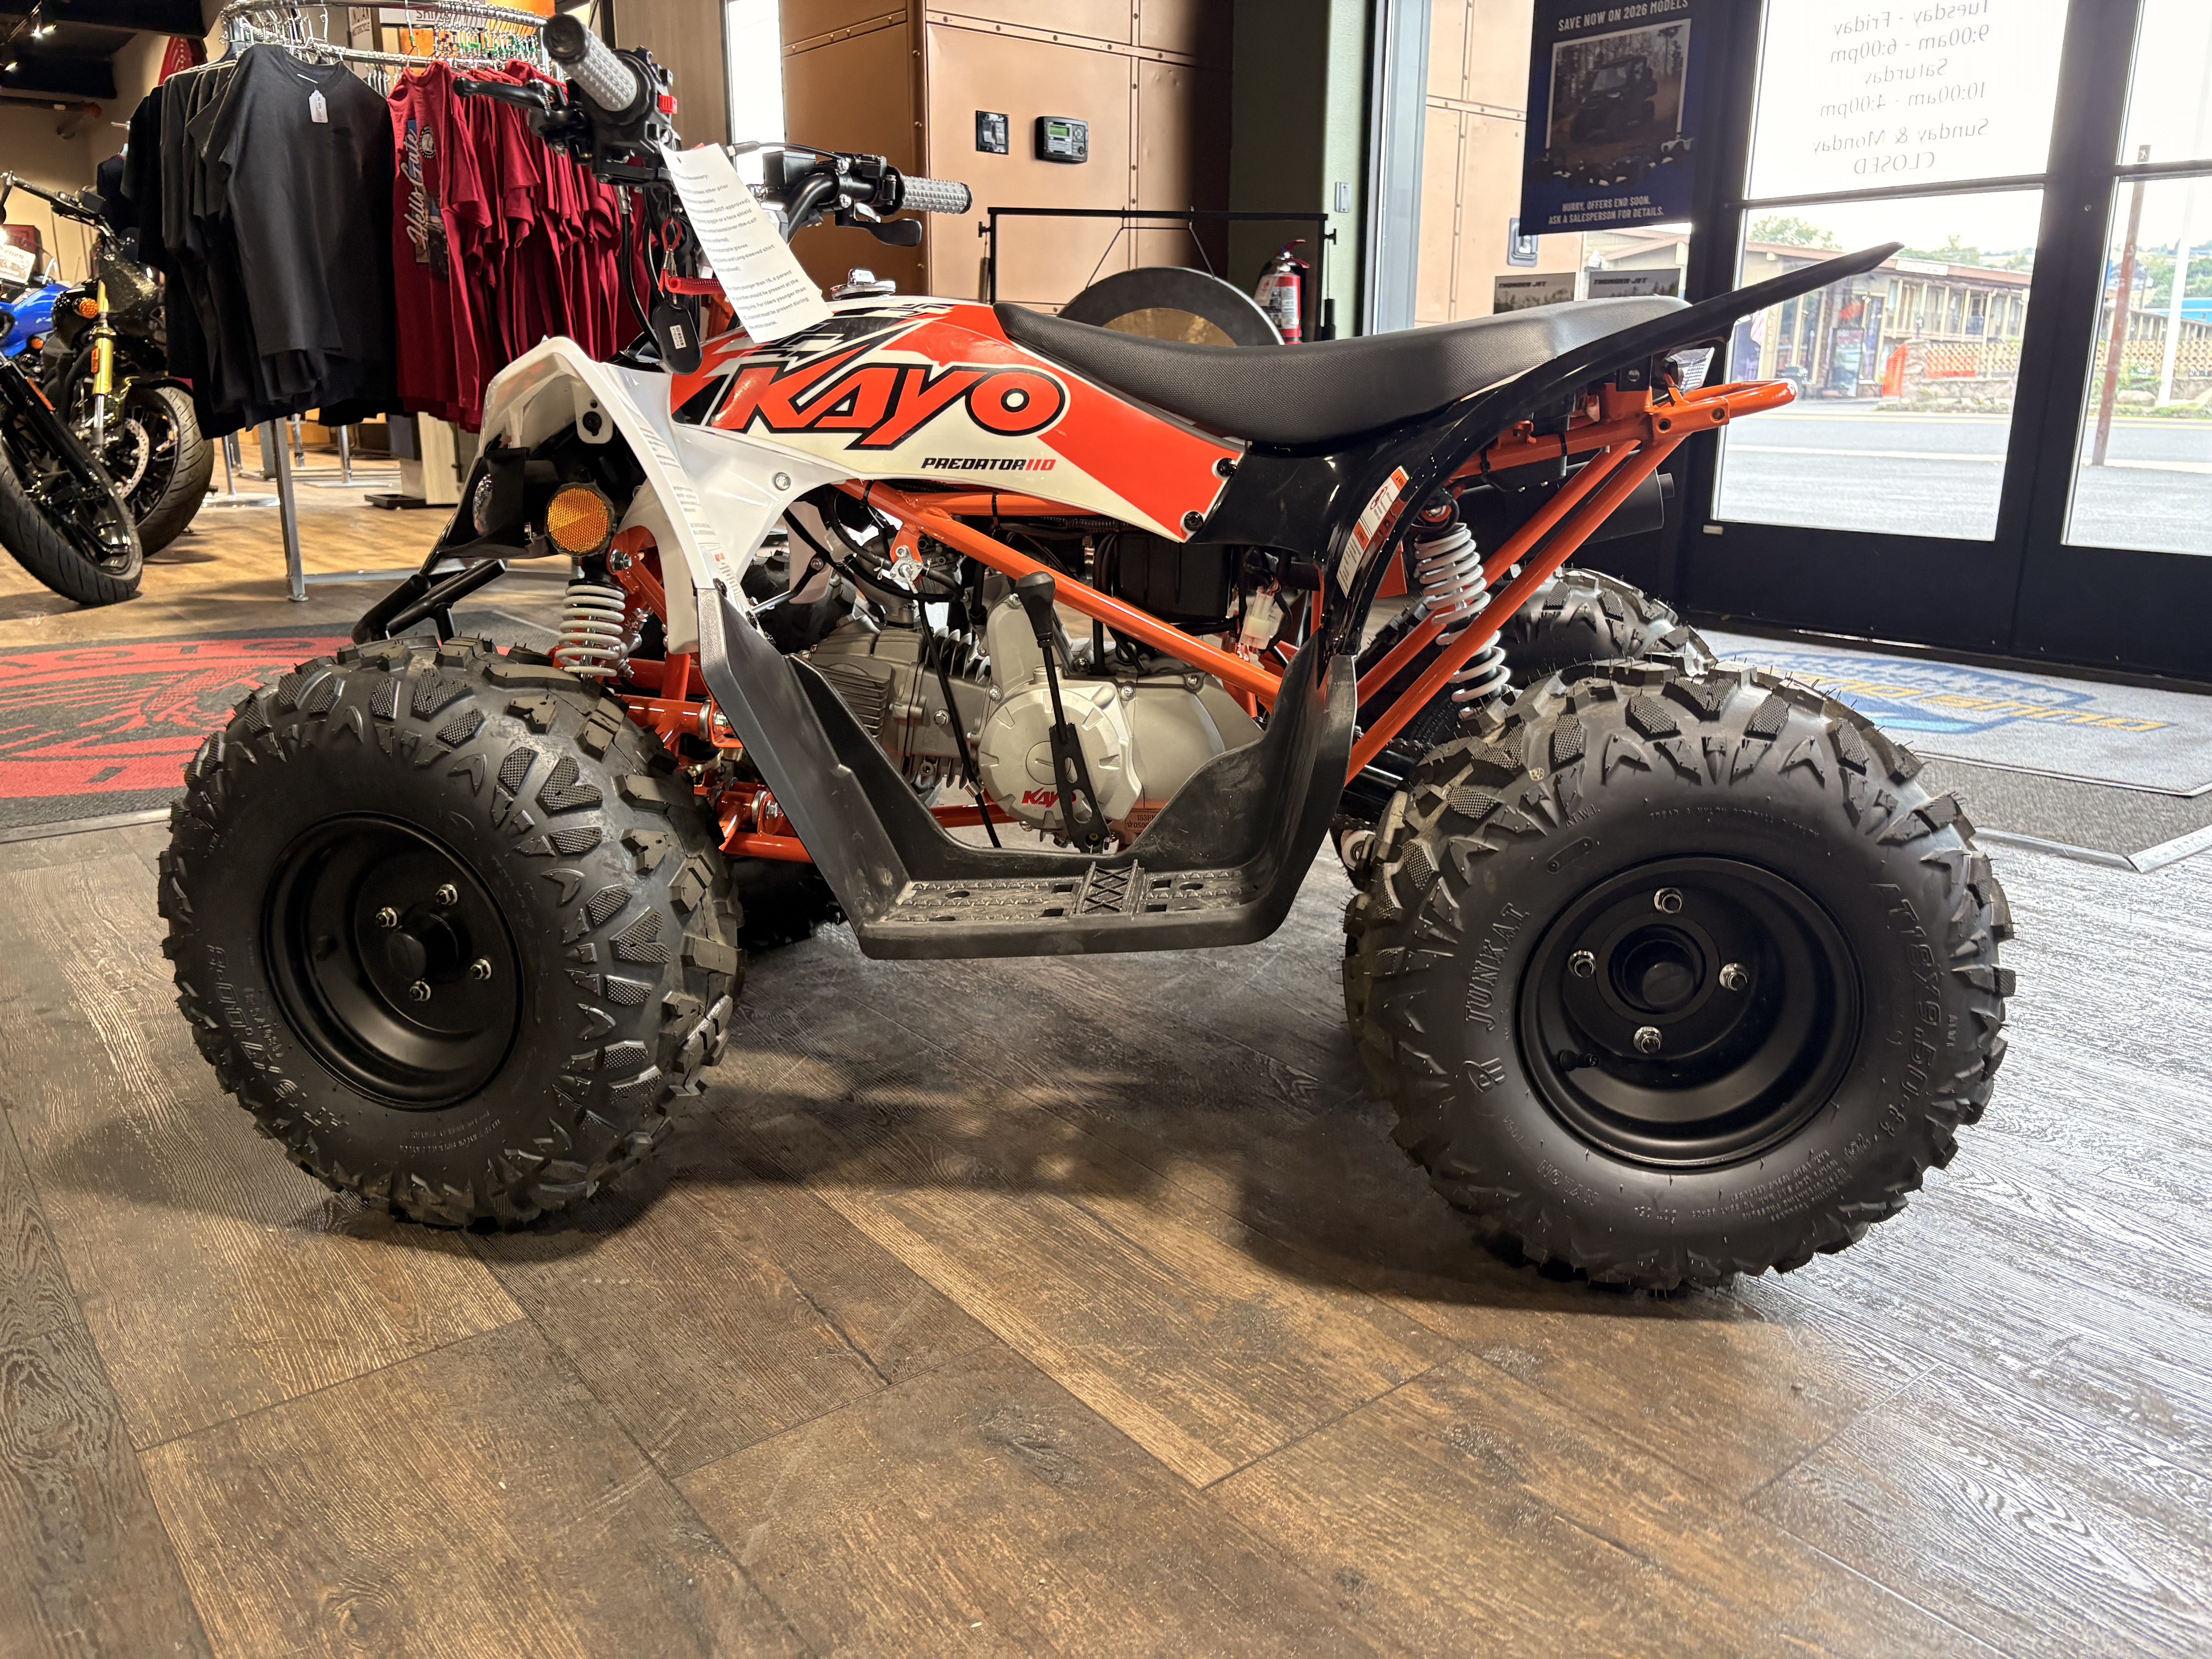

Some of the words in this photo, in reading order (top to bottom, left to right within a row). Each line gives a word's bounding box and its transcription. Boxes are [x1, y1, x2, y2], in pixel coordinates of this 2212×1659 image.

[1558, 16, 1582, 32] SAVE
[1583, 11, 1606, 27] NOW
[1608, 9, 1622, 22] ON
[1623, 4, 1648, 19] 2026
[1650, 0, 1688, 14] MODELS
[737, 208, 752, 216] shield
[1562, 202, 1585, 212] HURRY,
[1587, 199, 1613, 210] OFFERS
[1614, 198, 1628, 208] END
[1630, 196, 1651, 206] SOON.
[1549, 216, 1561, 224] ASK
[1563, 215, 1568, 223] A
[1569, 211, 1616, 223] SALESPERSON
[1618, 209, 1631, 219] FOR
[1633, 206, 1664, 218] DETAILS.
[776, 270, 792, 280] parent
[768, 284, 785, 294] present
[777, 292, 795, 302] younger
[776, 304, 793, 313] present
[793, 297, 809, 306] during
[706, 342, 1069, 451] KAYO
[1022, 788, 1077, 808] KAY
